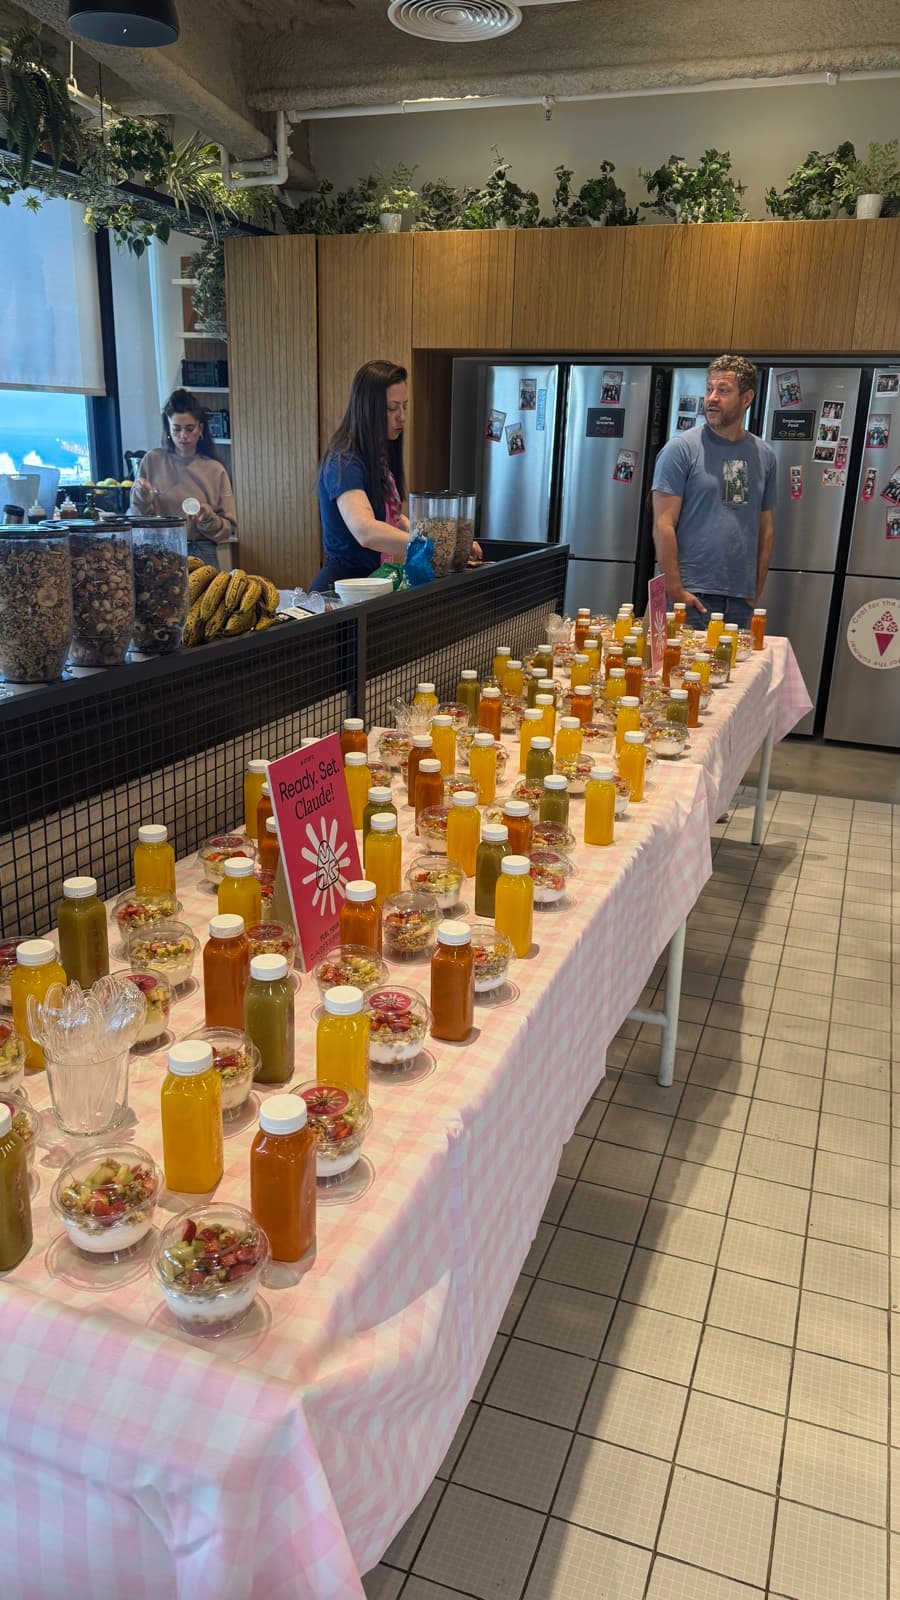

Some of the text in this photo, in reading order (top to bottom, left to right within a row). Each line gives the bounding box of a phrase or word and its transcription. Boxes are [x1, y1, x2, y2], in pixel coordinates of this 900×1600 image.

[882, 600, 896, 608] the
[278, 768, 319, 804] Ready.
[318, 758, 340, 780] Set.
[295, 782, 335, 820] Claude!
